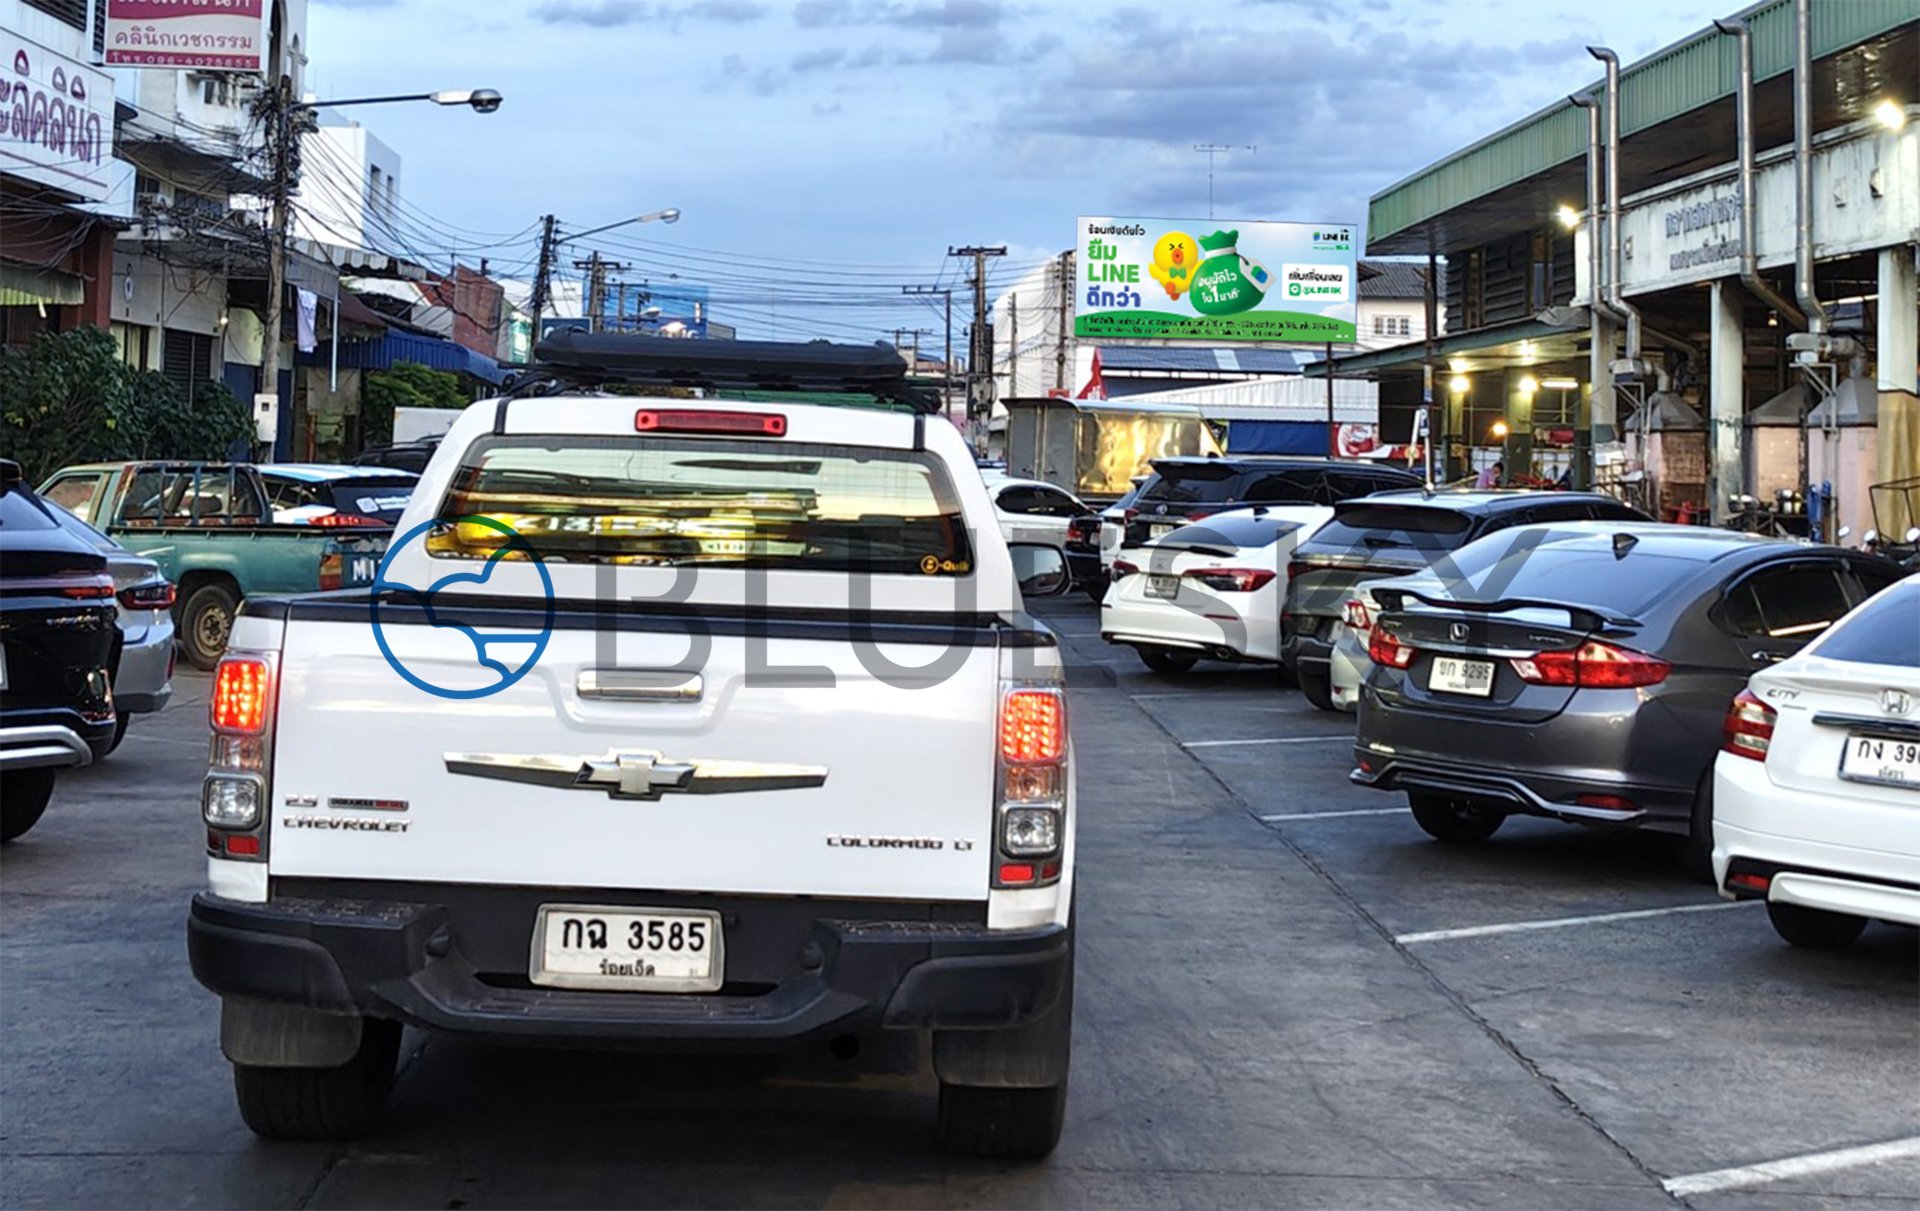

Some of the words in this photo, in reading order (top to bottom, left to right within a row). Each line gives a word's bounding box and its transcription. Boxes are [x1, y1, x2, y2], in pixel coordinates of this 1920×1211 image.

[115, 25, 252, 49] คลินิกเวชกรรม
[1088, 238, 1117, 260] ยืม
[1088, 263, 1140, 283] LINE
[1087, 285, 1141, 308] ดีกว่า
[353, 558, 383, 581] MI
[1460, 663, 1491, 680] 9295
[1767, 689, 1799, 699] CITY
[1857, 740, 1884, 760] กง
[1894, 744, 1920, 765] 39
[283, 815, 412, 833] CHEVROLET
[826, 834, 943, 850] COLORADO
[954, 837, 976, 851] LT
[562, 918, 608, 950] กฉ
[627, 920, 706, 952] 3585
[599, 958, 656, 977] ร้อยเอ็ด
